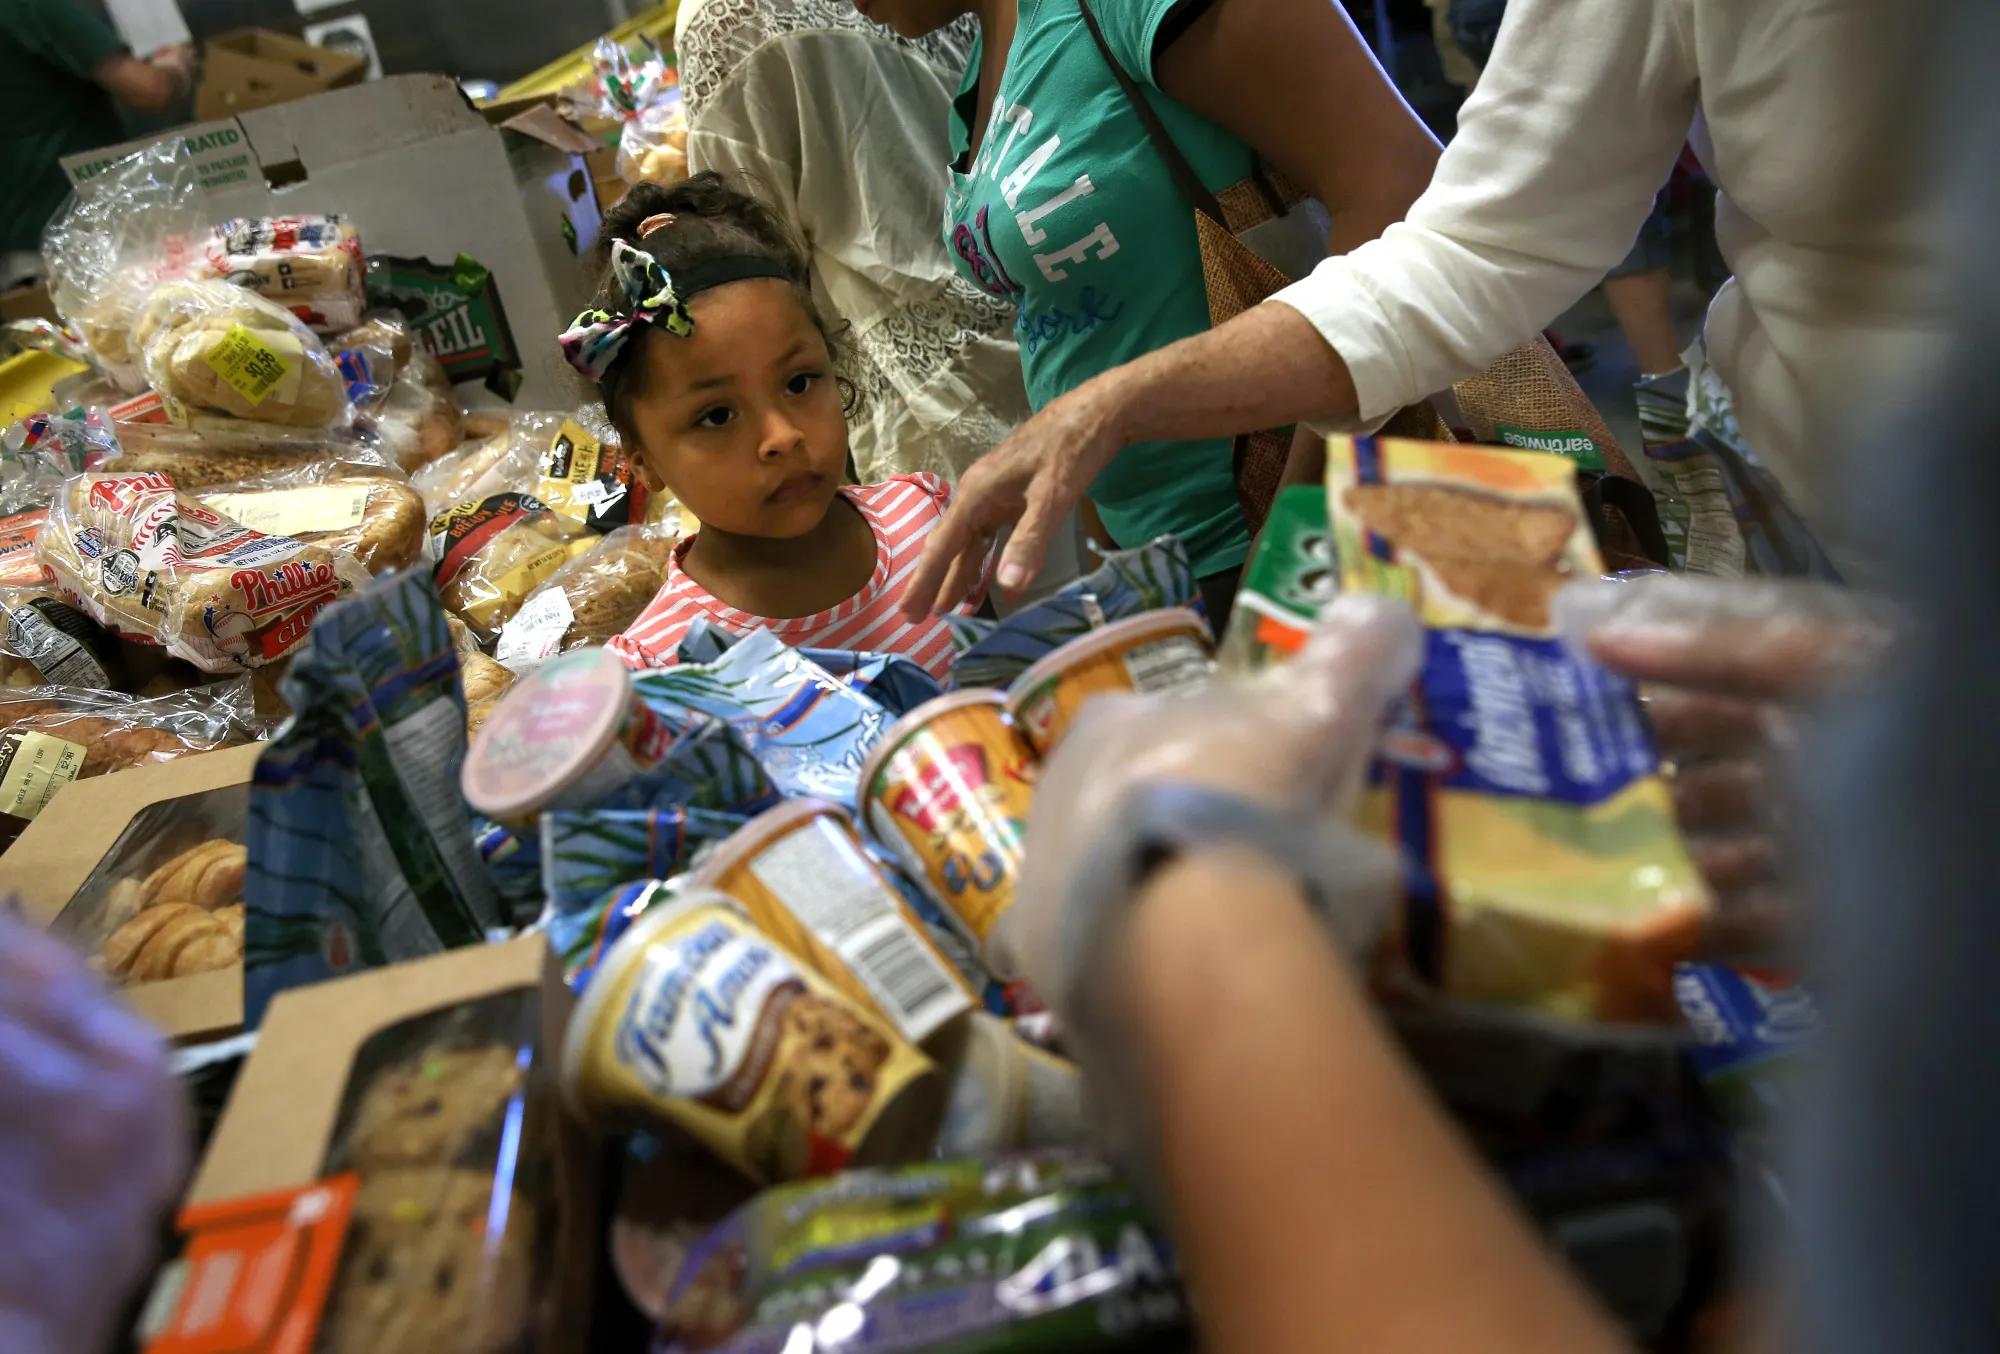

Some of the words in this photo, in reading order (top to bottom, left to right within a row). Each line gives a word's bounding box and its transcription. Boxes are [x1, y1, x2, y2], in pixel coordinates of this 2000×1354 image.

[244, 348, 276, 378] $0.56
[1503, 432, 1594, 454] earthwise
[233, 557, 248, 568] NET
[60, 751, 75, 770] $2.98
